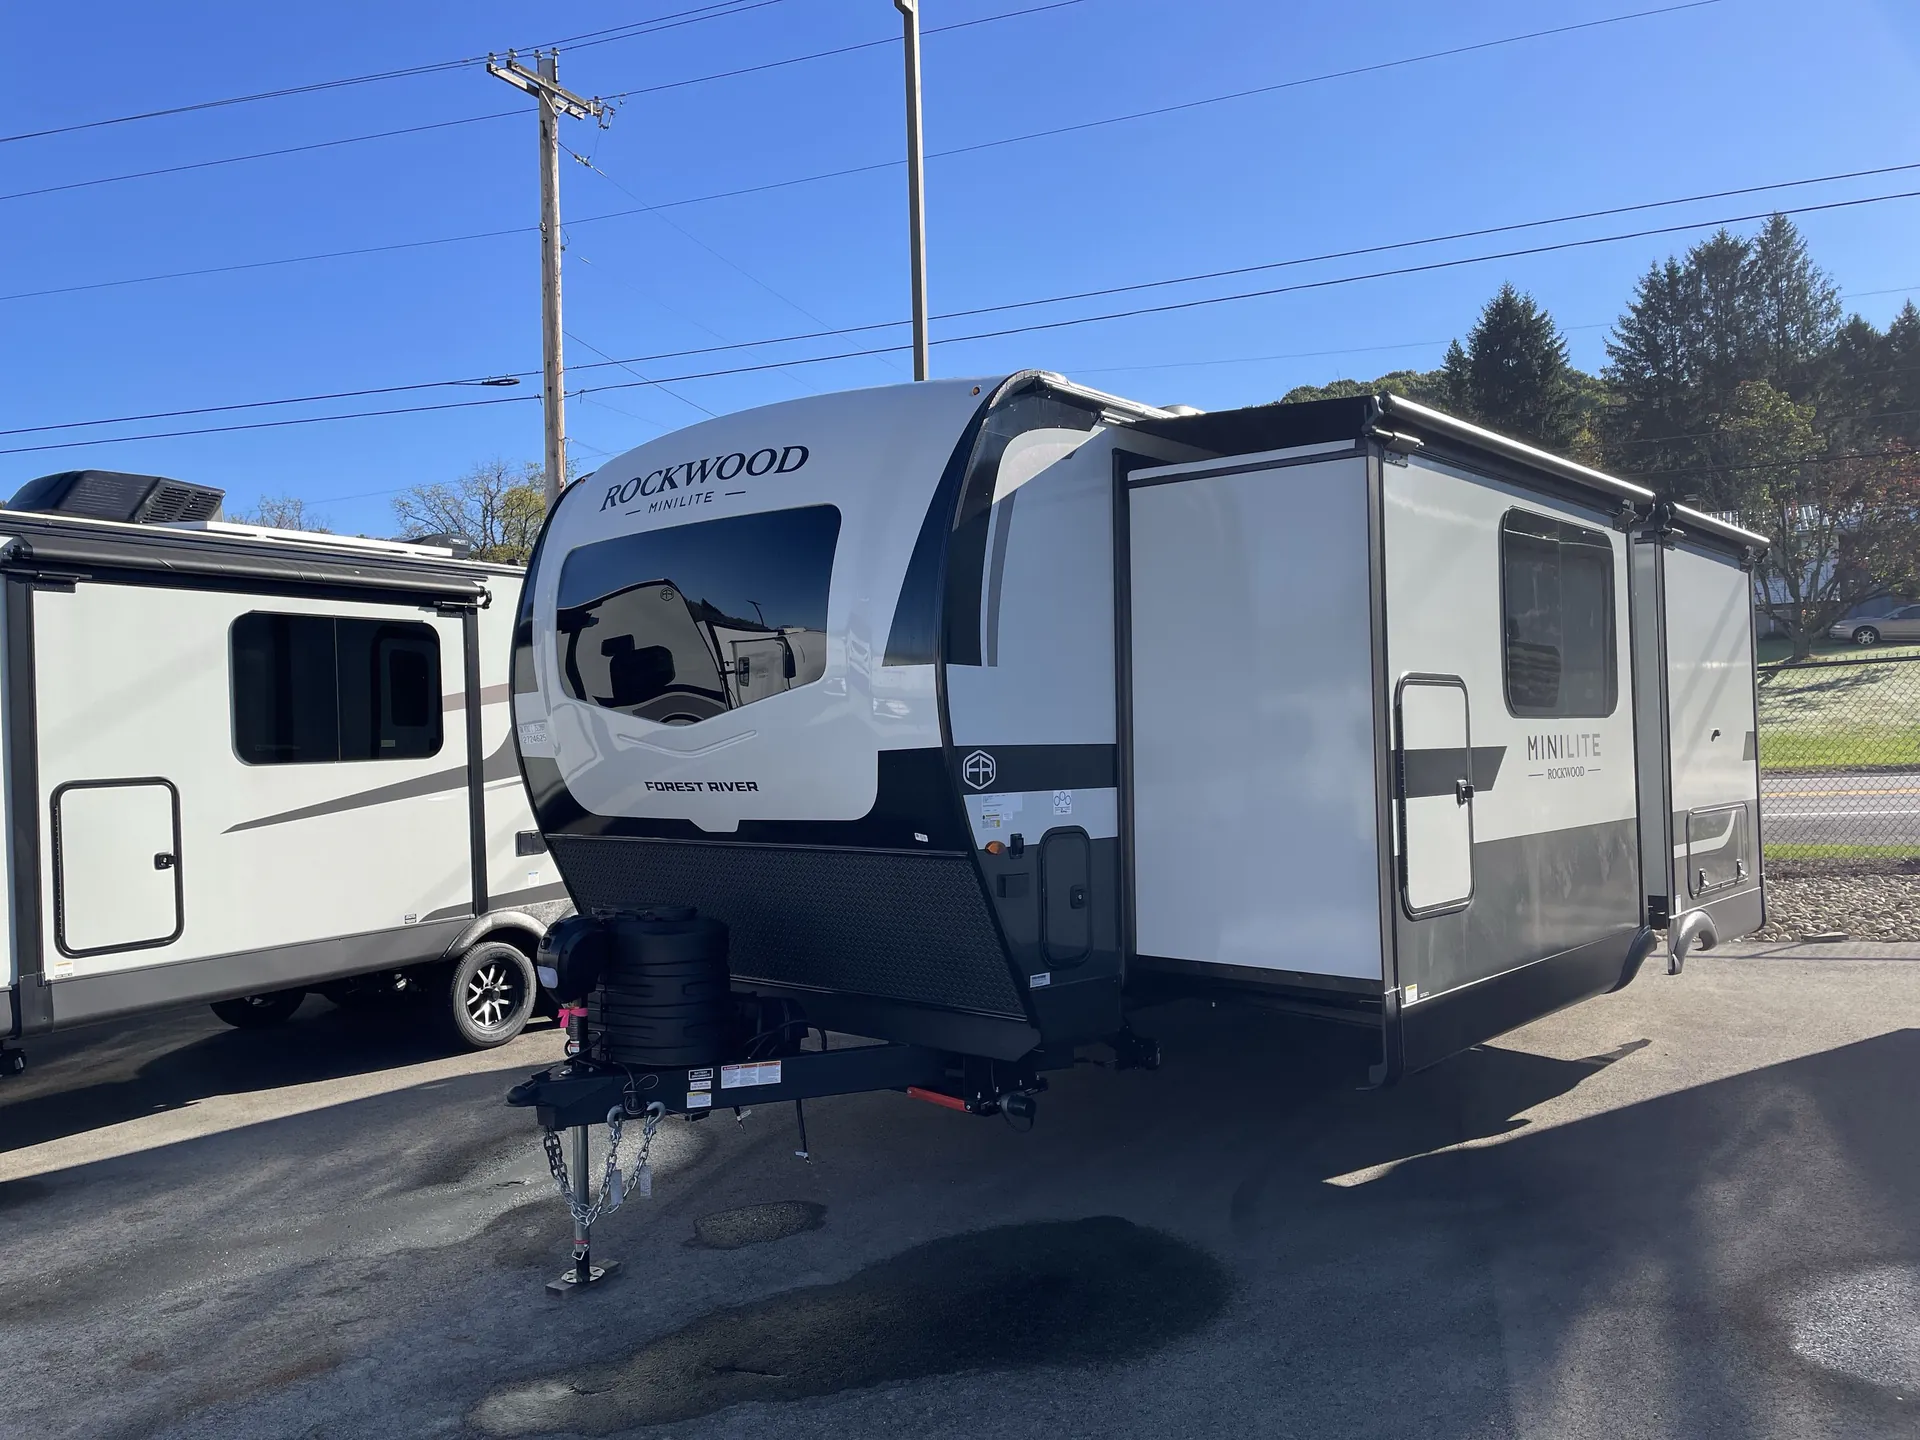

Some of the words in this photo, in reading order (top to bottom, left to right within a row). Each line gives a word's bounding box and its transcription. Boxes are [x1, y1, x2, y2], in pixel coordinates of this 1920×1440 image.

[599, 445, 810, 513] ROCKWOOD
[649, 491, 715, 514] MINILITE
[1527, 733, 1602, 761] MINILITE
[1547, 765, 1585, 779] ROCKWOOD
[644, 781, 704, 792] FOREST
[706, 781, 760, 792] RIVER
